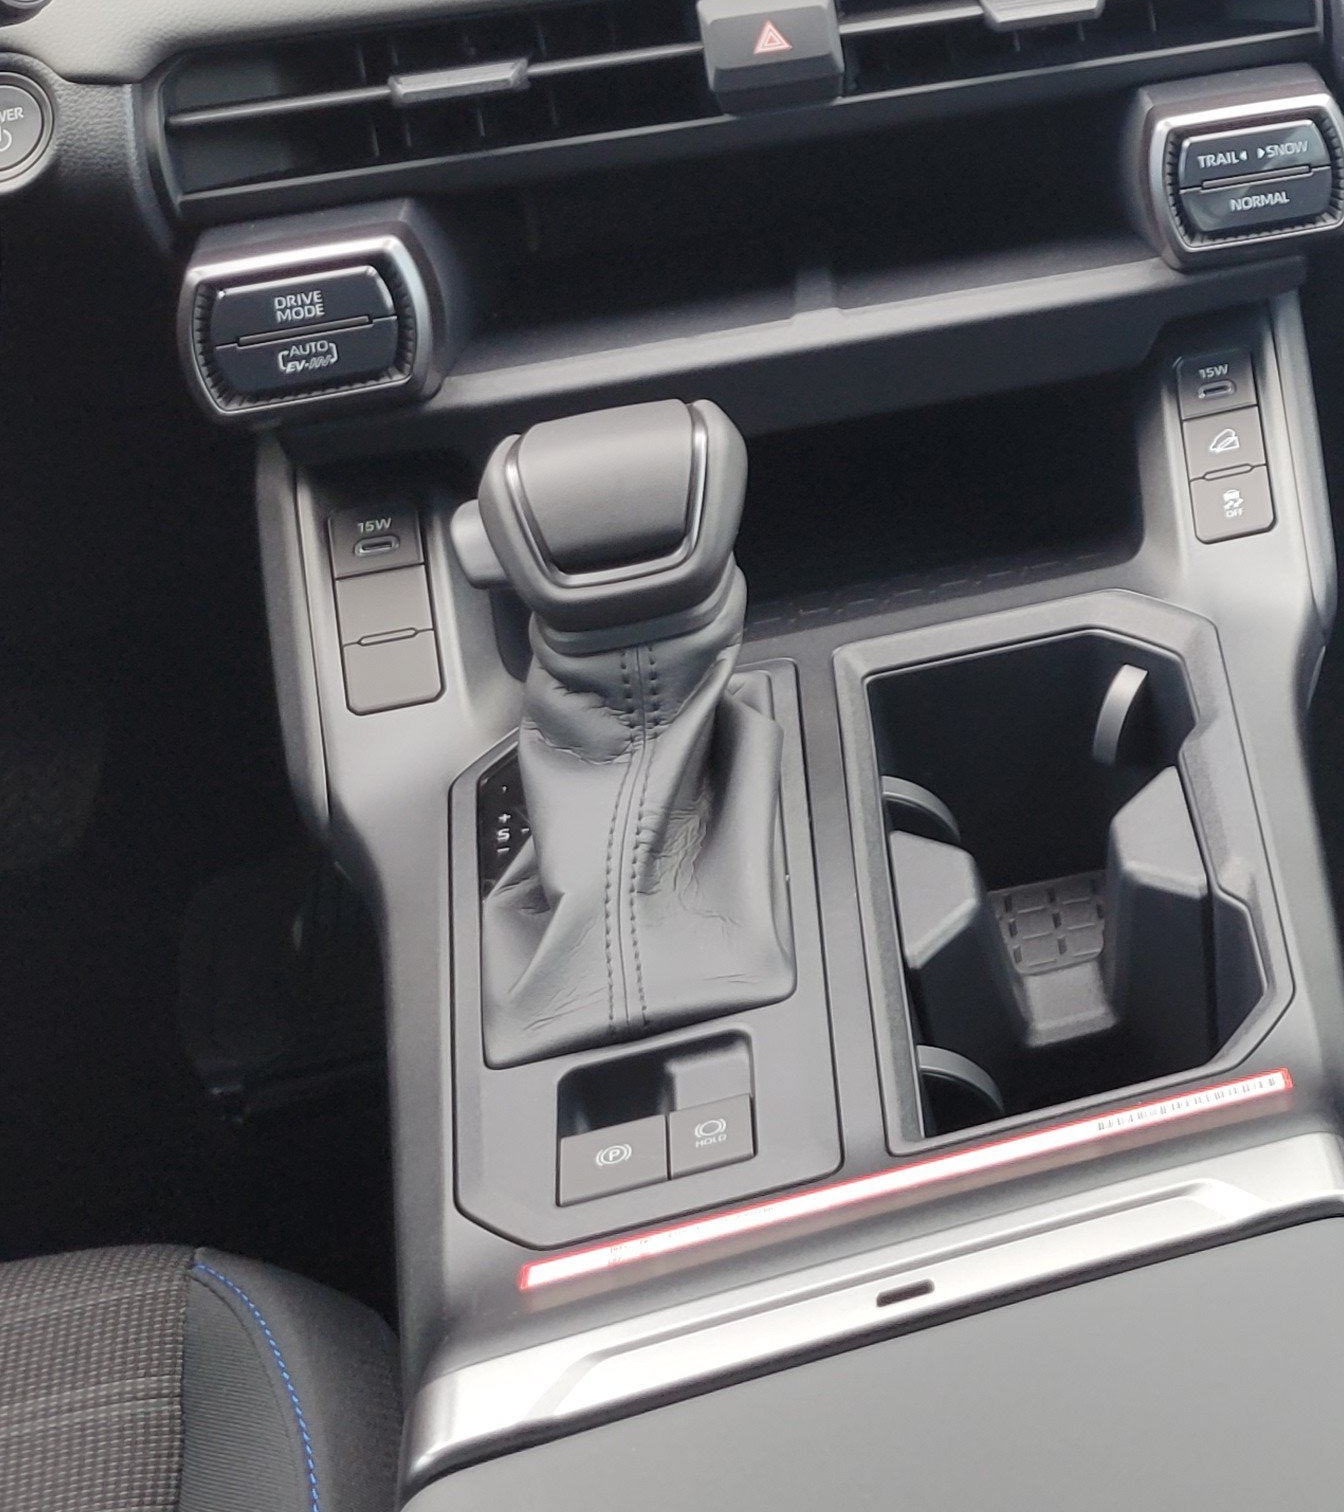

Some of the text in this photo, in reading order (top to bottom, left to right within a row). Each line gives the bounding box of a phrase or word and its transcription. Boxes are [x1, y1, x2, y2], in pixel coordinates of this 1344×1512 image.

[1197, 141, 1308, 168] TRAIL SNOW
[1229, 191, 1290, 211] NORMAL
[274, 290, 322, 310] DRIVE
[276, 304, 325, 323] MODE
[290, 340, 329, 357] AUTO
[1199, 364, 1229, 379] 15W
[1226, 508, 1244, 518] OFF
[357, 517, 392, 533] 15W
[695, 1134, 727, 1148] HOLD
